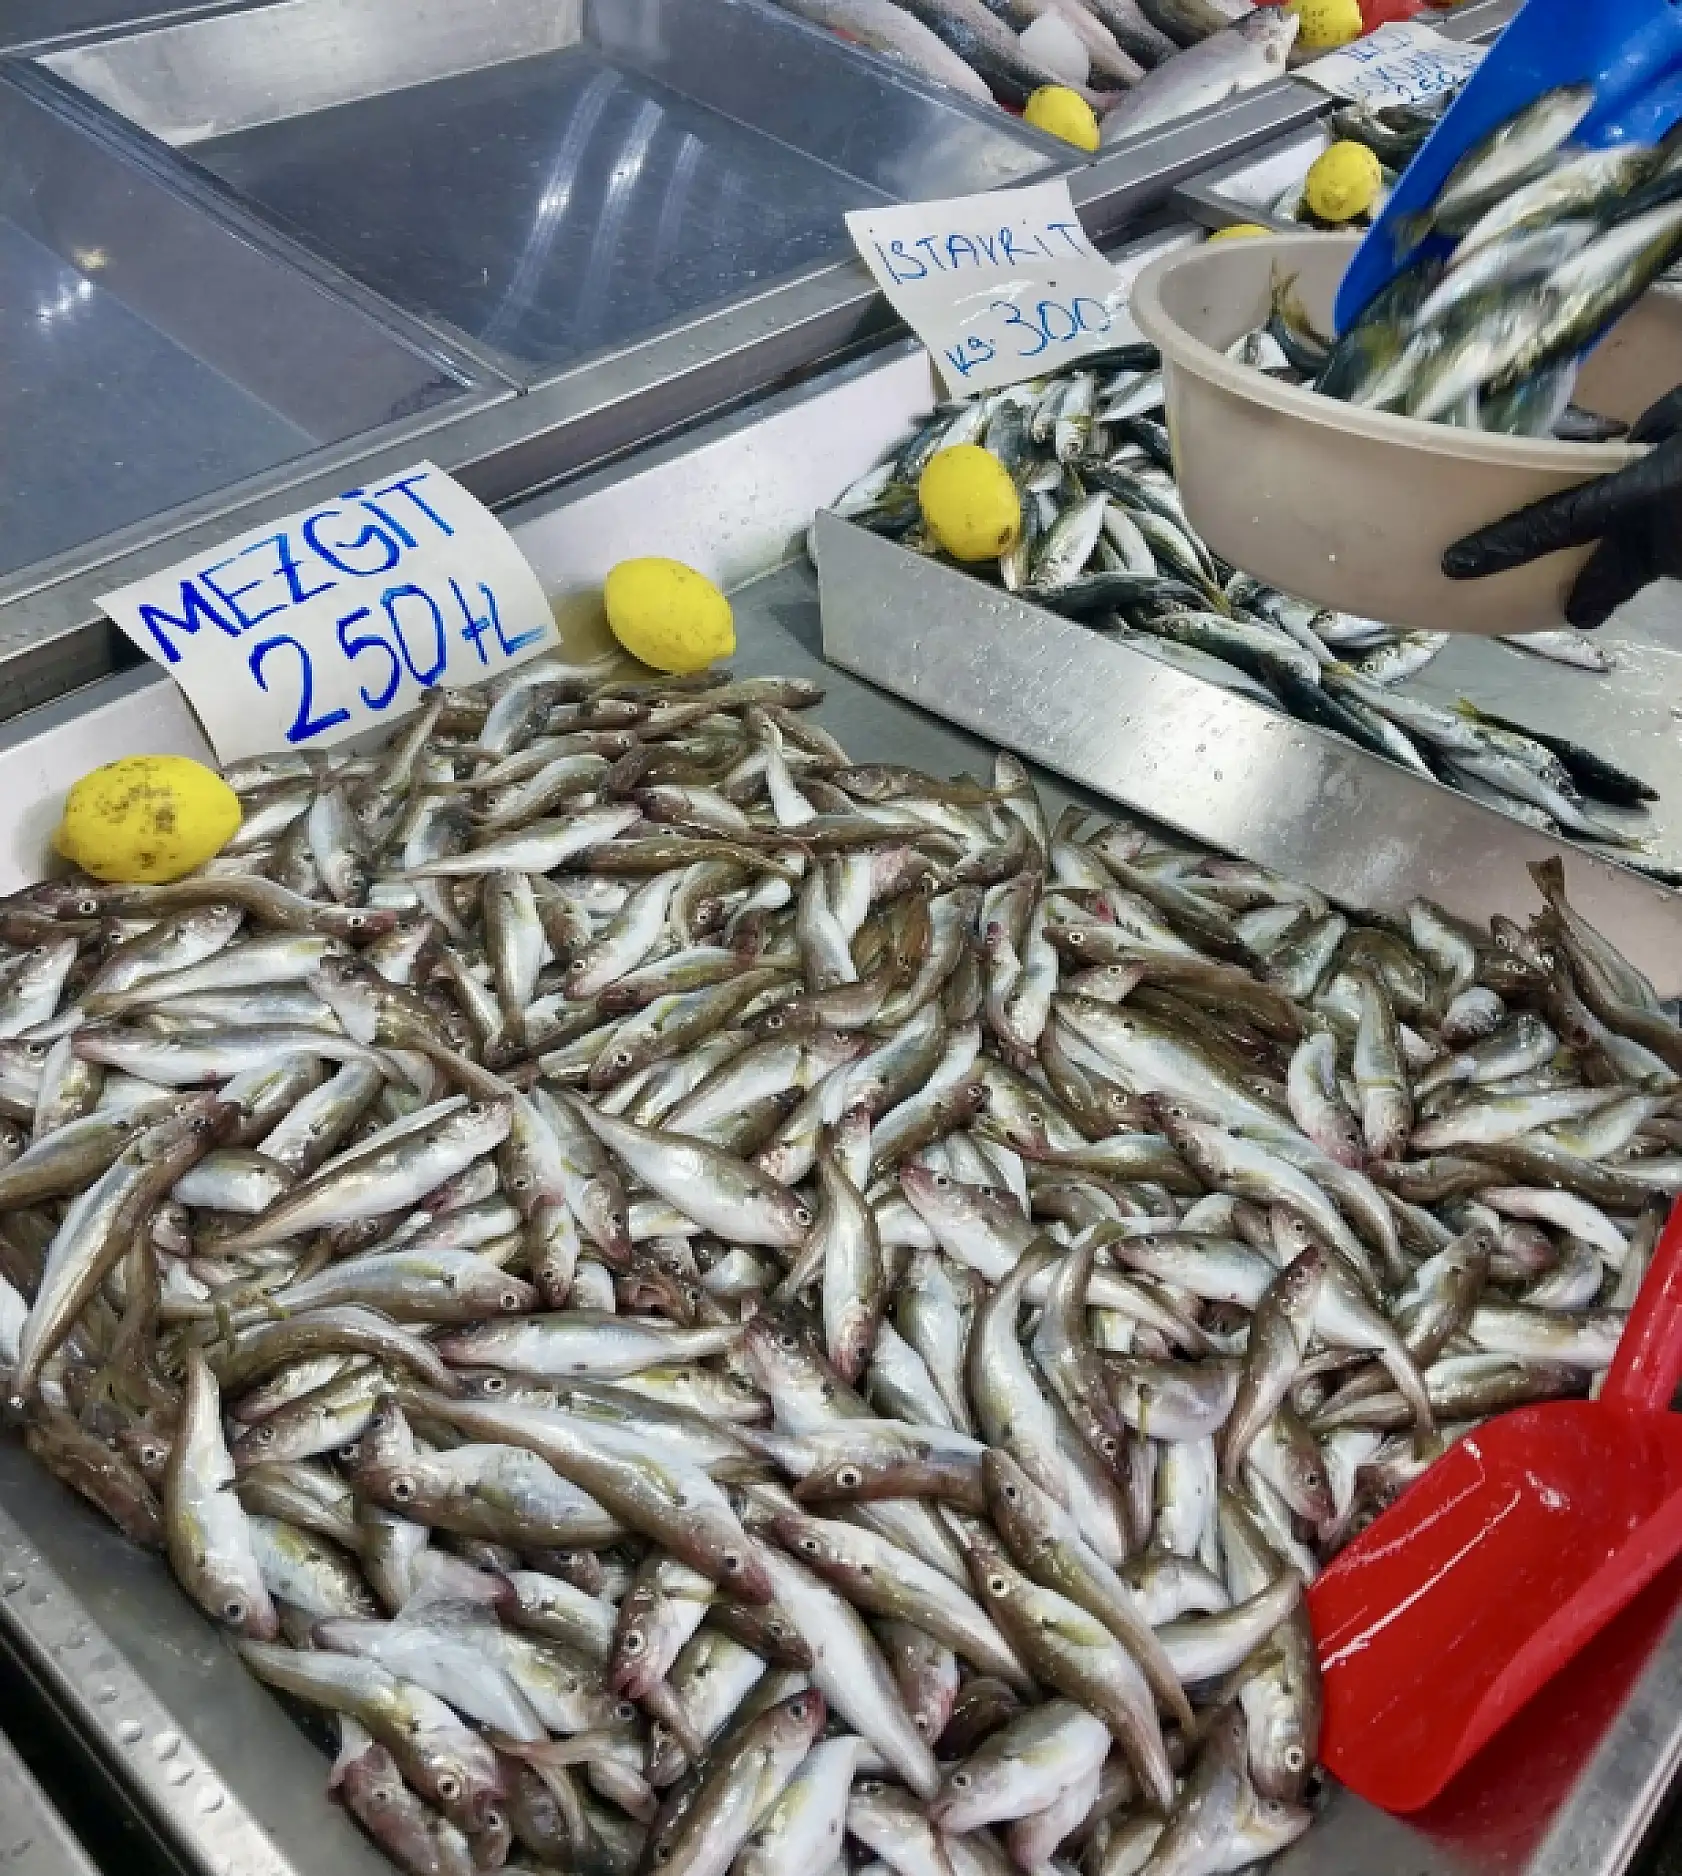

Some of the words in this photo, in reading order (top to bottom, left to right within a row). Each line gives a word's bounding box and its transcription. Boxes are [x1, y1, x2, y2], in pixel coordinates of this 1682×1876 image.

[989, 296, 1111, 357] 300
[138, 472, 455, 665] MEZGİT
[247, 582, 448, 744] 250
